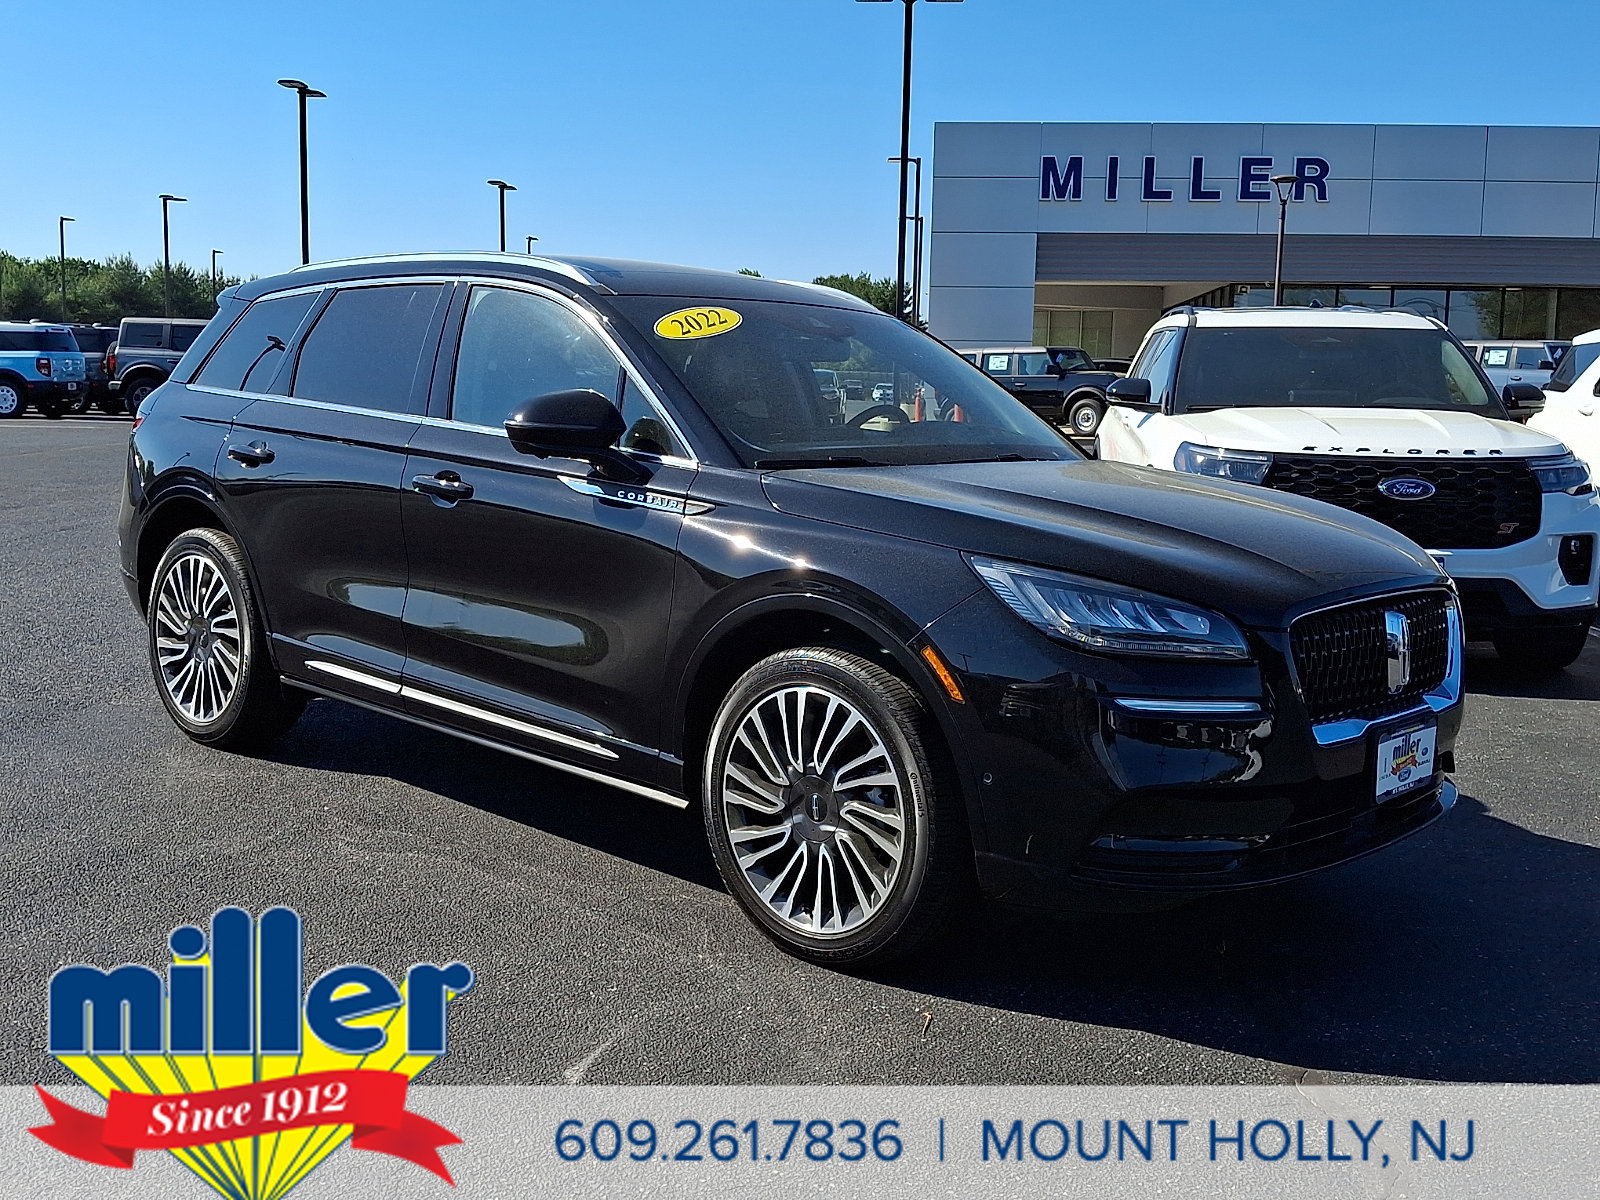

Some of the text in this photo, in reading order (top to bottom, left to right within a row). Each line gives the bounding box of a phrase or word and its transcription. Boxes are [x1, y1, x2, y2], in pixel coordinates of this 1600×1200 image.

[1039, 155, 1331, 202] MILLER
[670, 309, 729, 336] 2022
[1301, 445, 1504, 456] EXPLORER
[1392, 482, 1424, 495] Ford
[617, 490, 679, 509] CORSAIR
[1497, 522, 1520, 534] ST
[1392, 733, 1422, 760] miller
